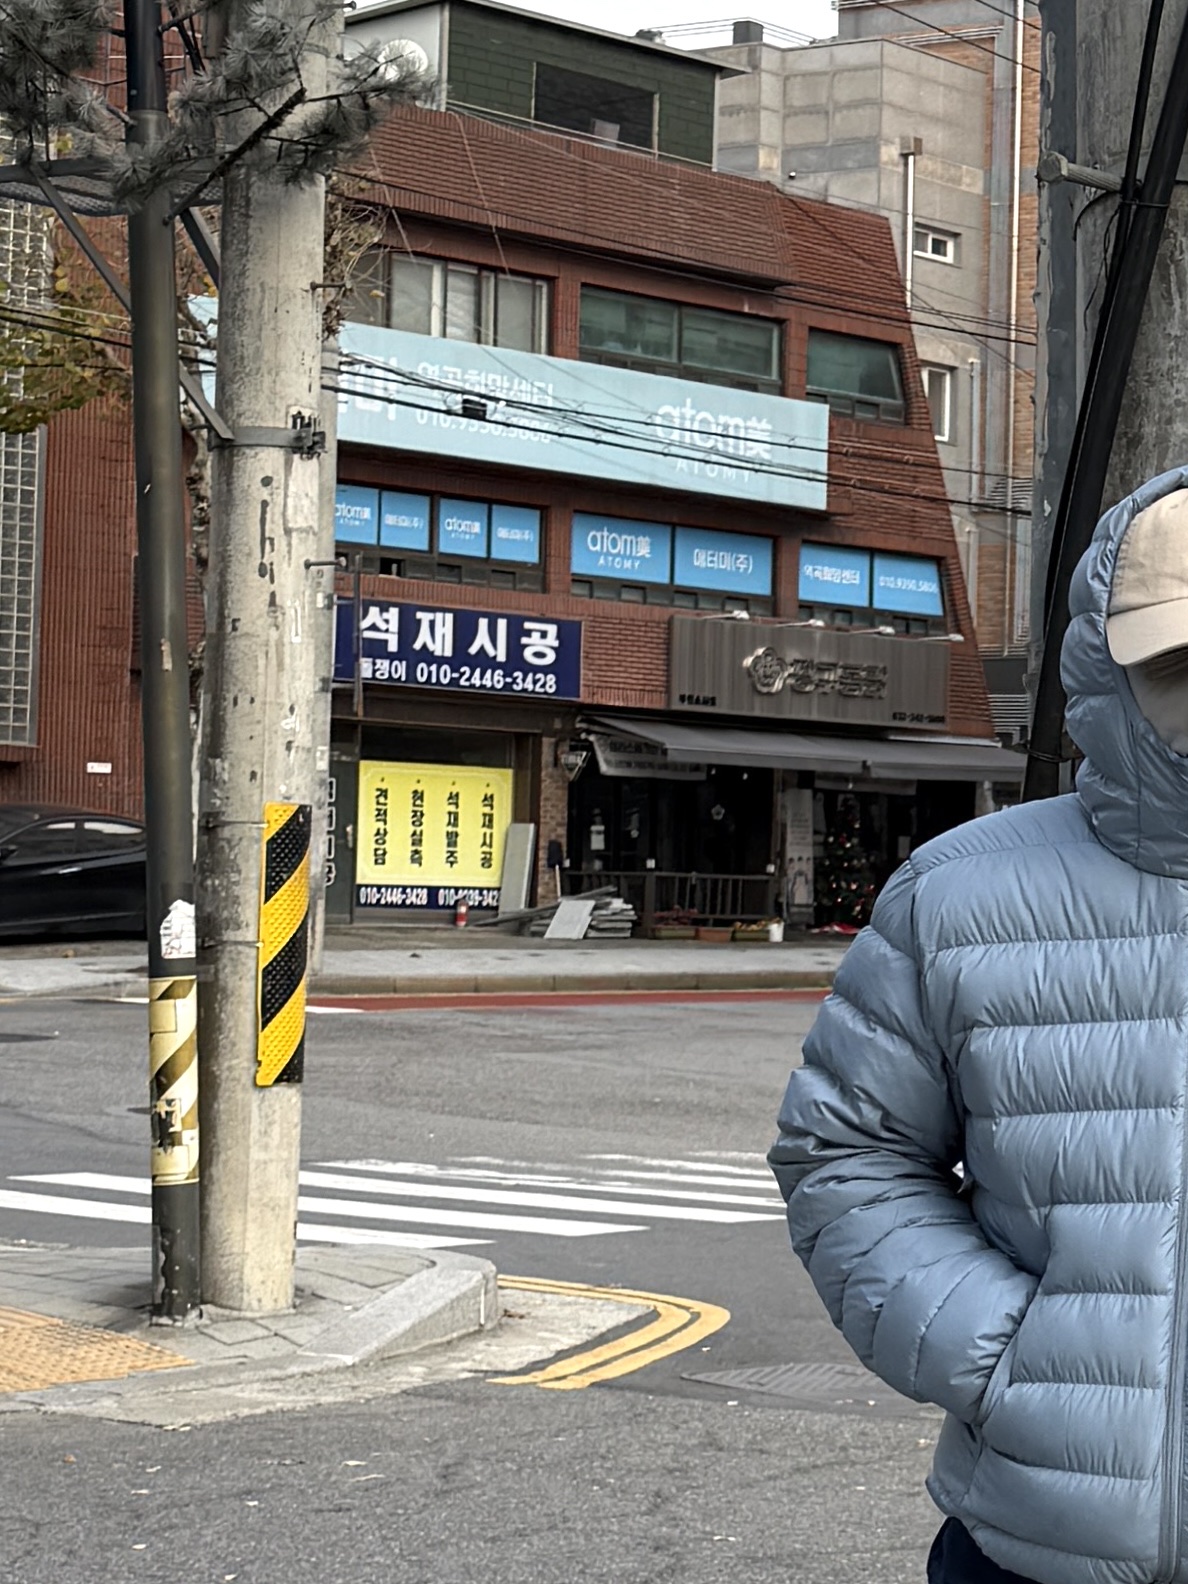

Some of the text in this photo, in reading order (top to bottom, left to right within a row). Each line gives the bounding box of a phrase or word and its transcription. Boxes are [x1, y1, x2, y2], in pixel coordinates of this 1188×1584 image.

[597, 555, 641, 570] ATOMY
[693, 548, 753, 574] 애터미(주)
[361, 605, 560, 666] 석재시공
[416, 662, 557, 694] 010-2446-3428
[373, 787, 389, 866] 견적상담
[410, 788, 425, 868] 현장실측
[445, 790, 460, 868] 석재발주
[480, 792, 494, 869] 석재시공
[359, 886, 428, 905] 010-2446-3428
